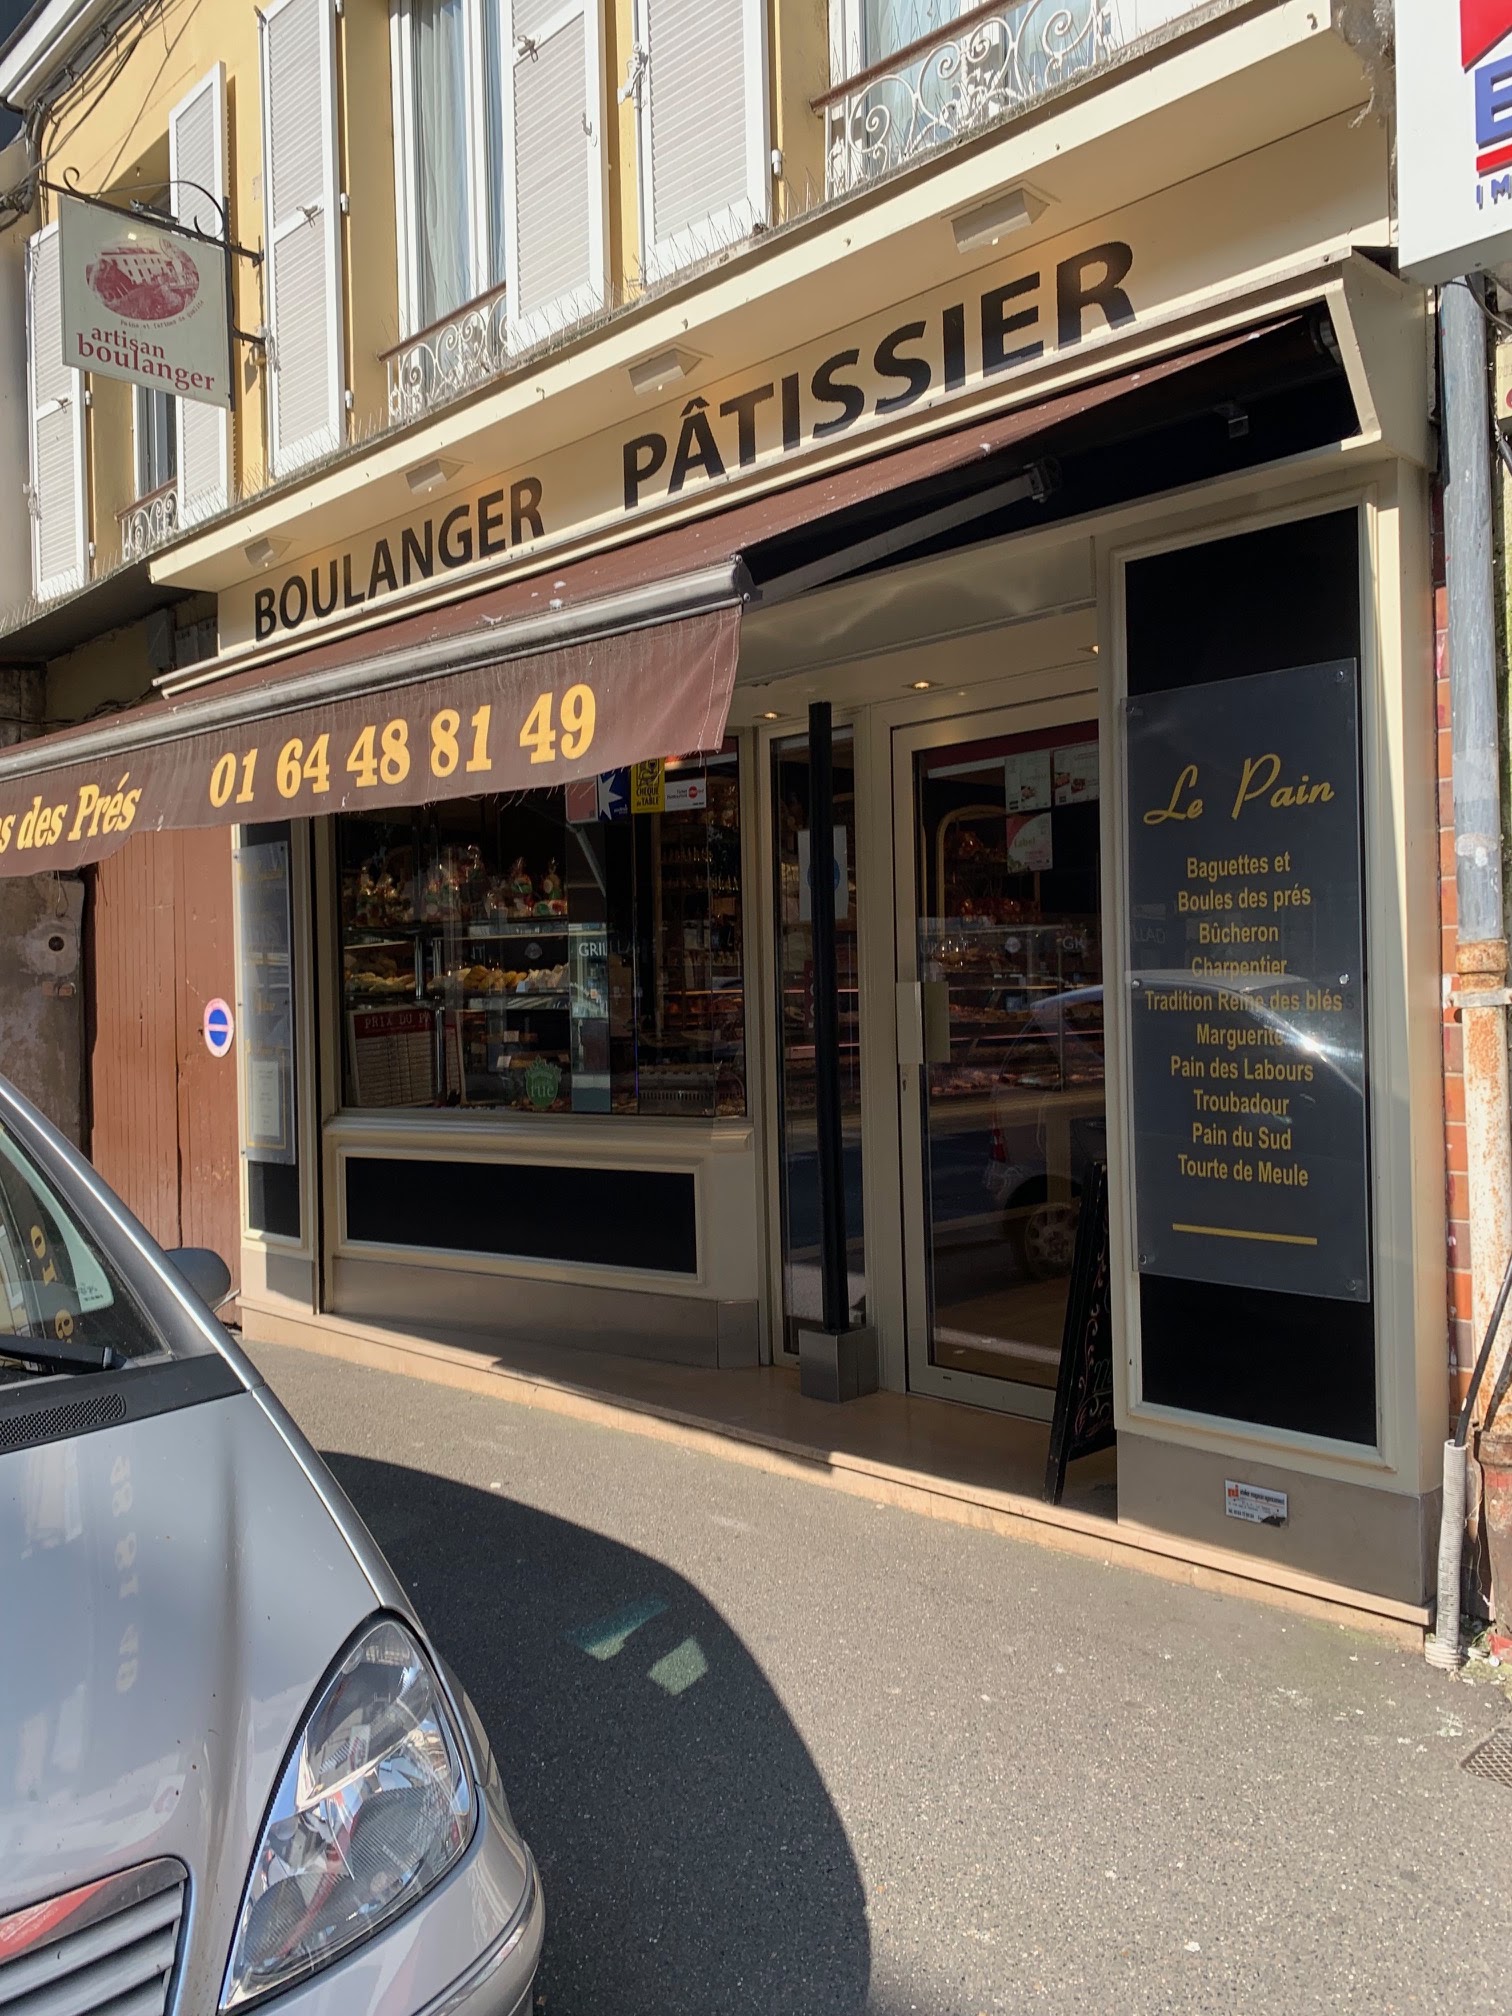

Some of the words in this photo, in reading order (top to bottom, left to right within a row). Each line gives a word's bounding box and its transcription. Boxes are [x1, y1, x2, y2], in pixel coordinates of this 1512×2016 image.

[91, 327, 165, 359] artisan
[77, 332, 215, 391] boulanger
[623, 241, 1136, 511] PÂTISSIER
[254, 477, 545, 642] BOULANGER
[209, 748, 258, 808] 01
[276, 733, 330, 798] 64
[346, 719, 411, 788] 48
[430, 705, 492, 778] 81
[519, 683, 596, 765] 49
[1143, 764, 1203, 825] Le
[1231, 753, 1334, 820] Pain
[17, 796, 68, 850] des
[68, 772, 142, 841] Prés
[1187, 855, 1269, 882] Baguettes
[1274, 851, 1290, 872] et
[1178, 888, 1233, 912] Boules
[1238, 887, 1267, 908] des
[1273, 883, 1311, 912] prés
[1200, 922, 1279, 944] Bûcheron
[1192, 955, 1287, 981] Charpentier
[1145, 990, 1212, 1011] Tradition
[1218, 992, 1264, 1011] Reine
[1270, 990, 1299, 1011] des
[1306, 988, 1343, 1011] blés
[1171, 1056, 1204, 1078] Pain
[1210, 1057, 1238, 1079] des
[1244, 1058, 1314, 1081] Labours
[1194, 1089, 1290, 1115] Troubadour
[1193, 1122, 1226, 1146] Pain
[1232, 1125, 1252, 1147] du
[1258, 1126, 1291, 1150] Sud
[1178, 1154, 1228, 1179] Tourte
[1233, 1160, 1252, 1181] de
[1258, 1161, 1309, 1187] Meule
